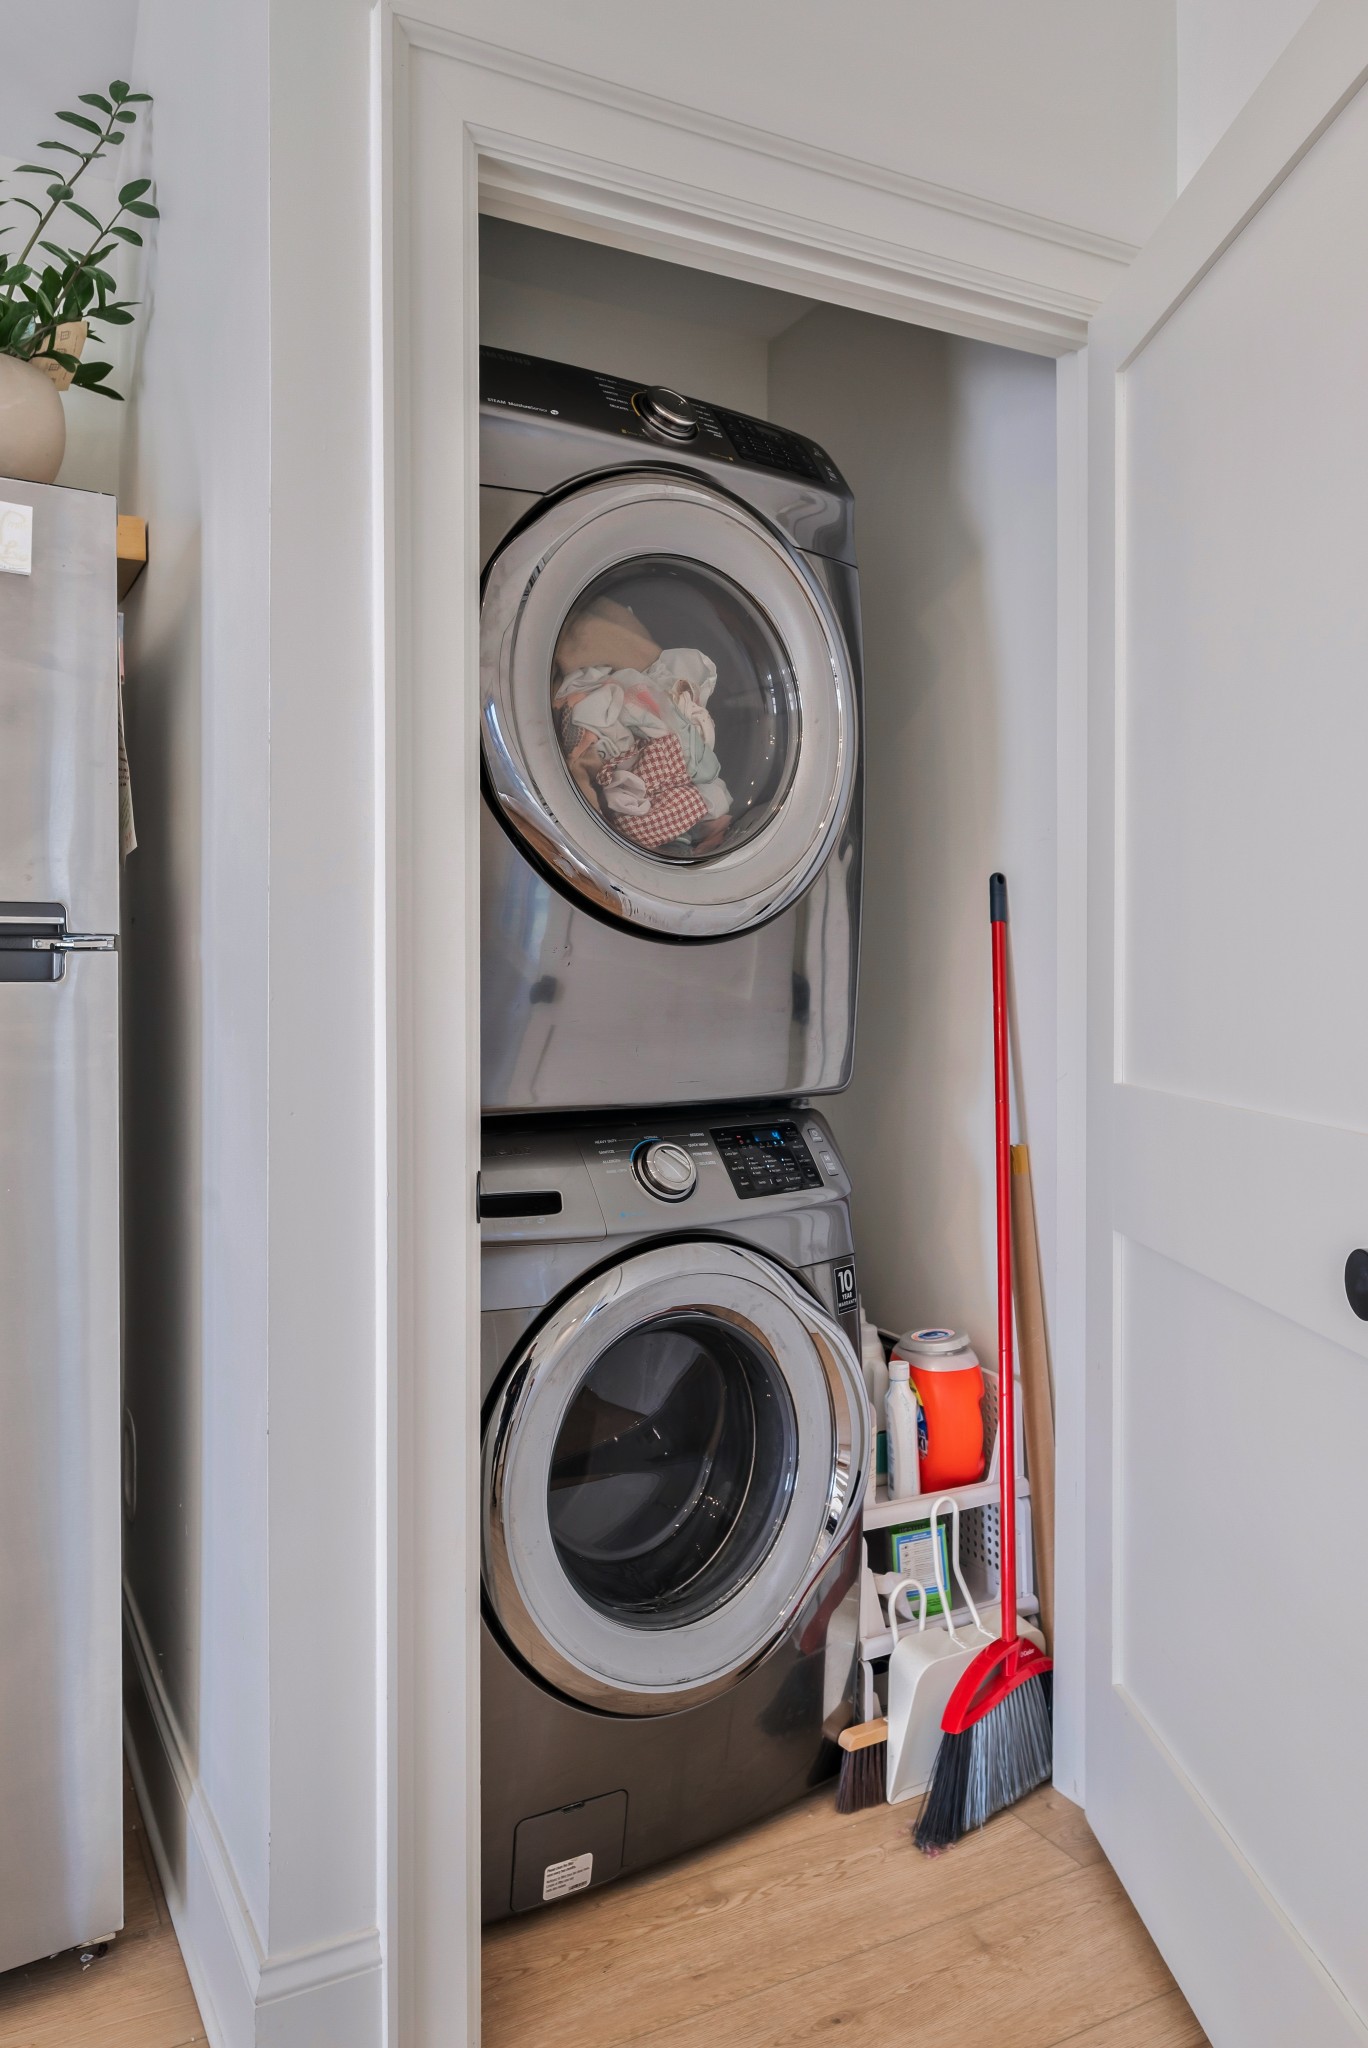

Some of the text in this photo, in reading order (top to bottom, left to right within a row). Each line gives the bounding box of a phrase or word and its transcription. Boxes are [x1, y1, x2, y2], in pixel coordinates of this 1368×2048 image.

[487, 397, 507, 405] STEAM
[838, 1269, 853, 1293] 10
[842, 1291, 853, 1301] YEAR
[838, 1298, 857, 1308] WARRANTY
